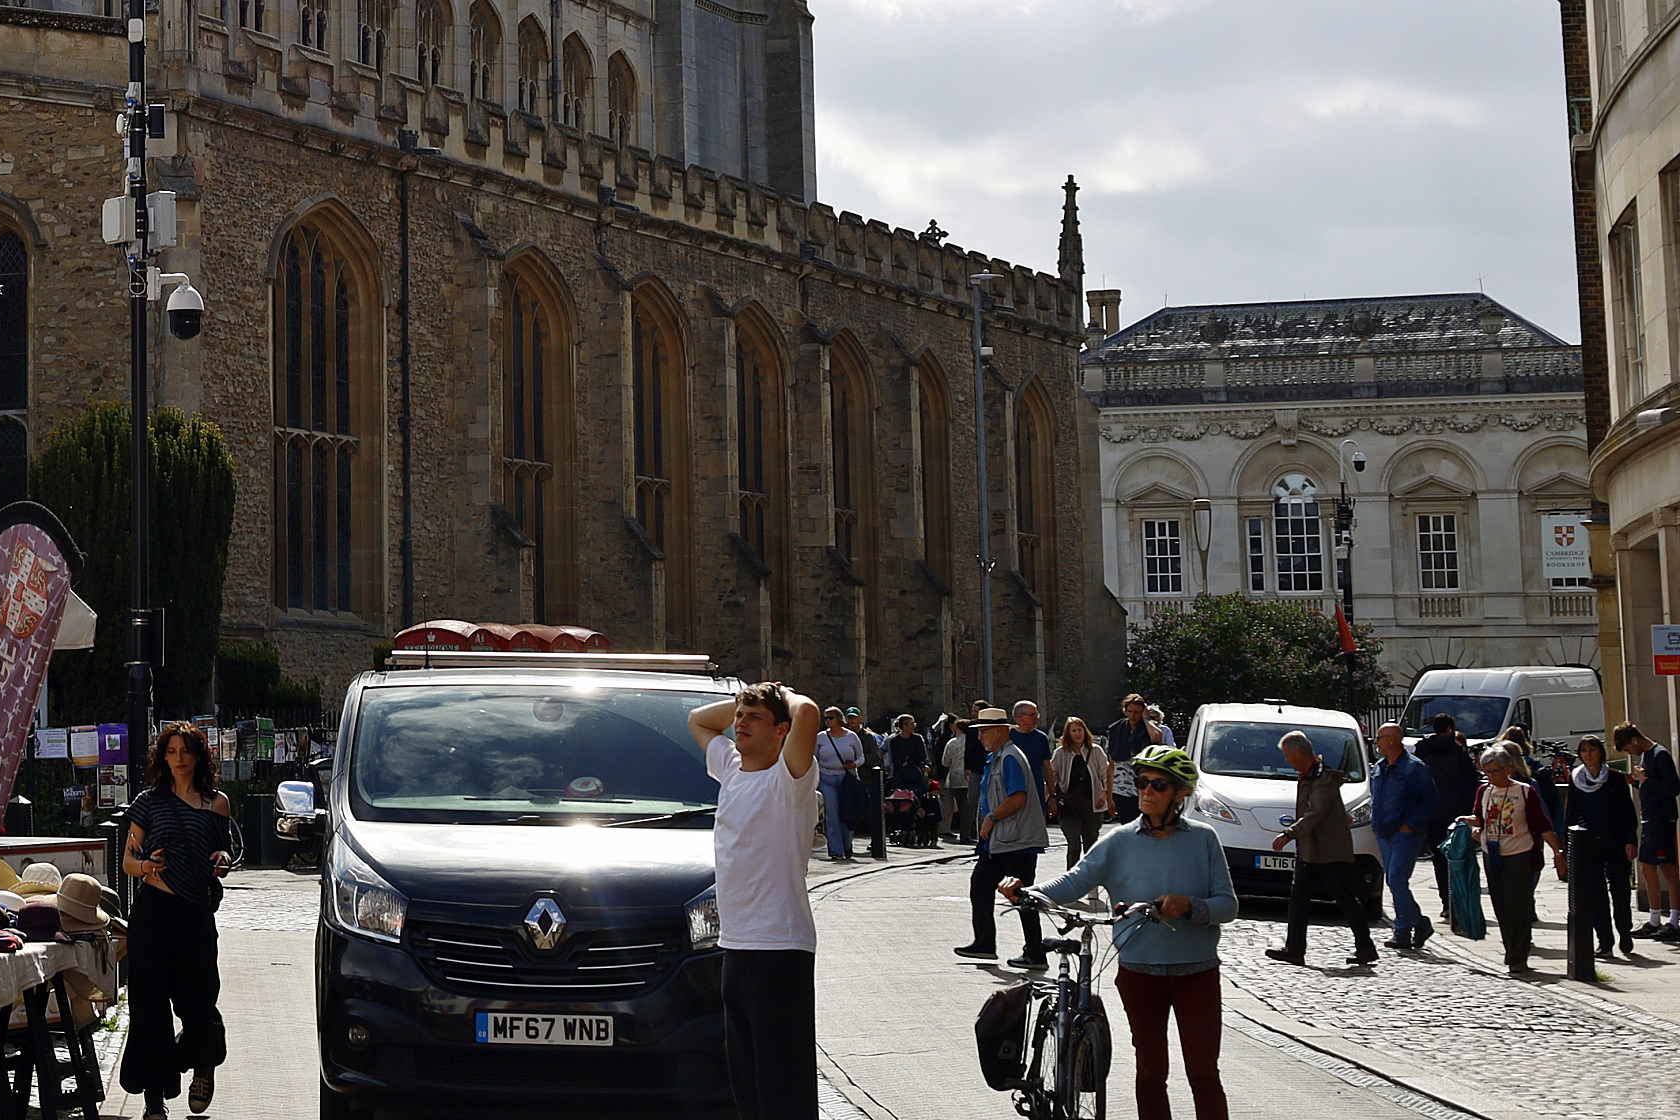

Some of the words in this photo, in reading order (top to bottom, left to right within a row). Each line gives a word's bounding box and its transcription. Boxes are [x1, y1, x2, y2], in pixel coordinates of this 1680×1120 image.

[1264, 857, 1289, 869] LT16
[493, 1016, 556, 1040] MF67
[563, 1018, 610, 1041] WNB
